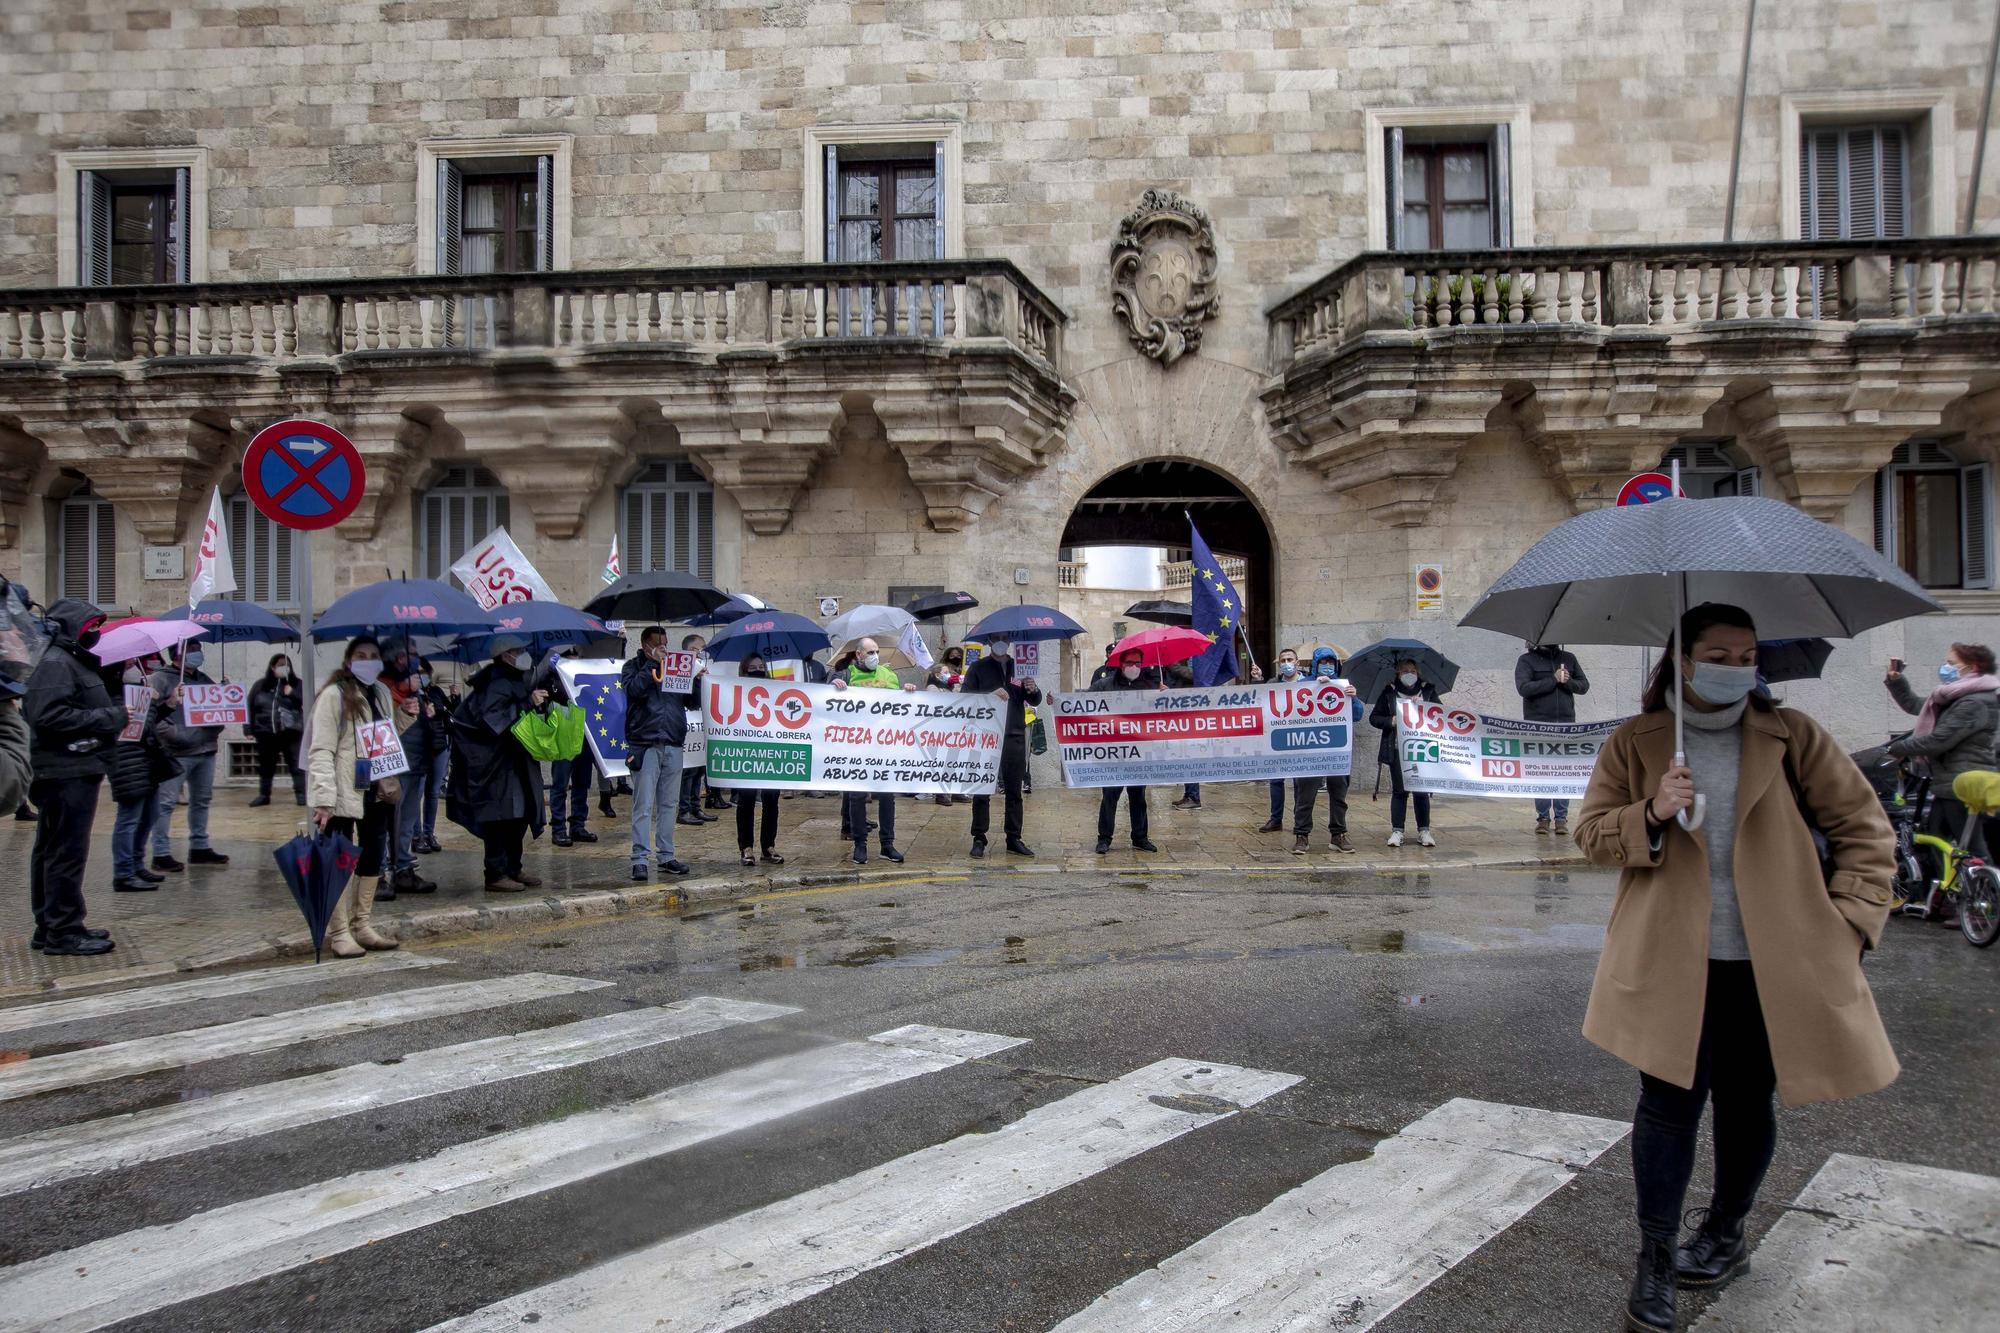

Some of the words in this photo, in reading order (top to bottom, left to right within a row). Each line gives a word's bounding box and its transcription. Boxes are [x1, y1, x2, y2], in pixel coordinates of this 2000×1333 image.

[1016, 644, 1037, 660] 16
[667, 653, 692, 672] 18
[188, 685, 244, 704] USO
[1060, 699, 1110, 714] CADA
[1154, 695, 1211, 710] FIXESA
[1218, 689, 1257, 706] ARA!
[1269, 686, 1345, 718] USO
[710, 684, 813, 730] USO
[825, 698, 866, 714] STOP
[870, 701, 912, 716] OPES
[915, 704, 996, 720] ILEGALES
[203, 710, 236, 722] CAIB
[1288, 718, 1316, 726] SINDICAL
[1319, 716, 1347, 724] OBRERA
[1403, 703, 1476, 735] USO
[708, 727, 731, 736] UNIÓ
[733, 729, 774, 738] SINDICAL
[776, 731, 812, 740] OBRERA
[1062, 720, 1115, 736] INTERÍ
[1120, 721, 1141, 735] EN
[1146, 718, 1190, 733] FRAU
[1195, 717, 1217, 731] DE
[1222, 715, 1257, 730] LLEI
[1540, 725, 1569, 733] DRET
[1570, 725, 1585, 734] DE
[824, 725, 872, 745] FIJEZA
[877, 728, 916, 747] COMO
[920, 725, 977, 749] SANCIÓN
[981, 731, 999, 750] YA!
[1286, 730, 1330, 747] IMAS
[1420, 732, 1447, 740] SINDICAL
[712, 747, 789, 759] AJUNTAMENT
[792, 751, 806, 760] DE
[1064, 746, 1141, 761] IMPORTA
[1488, 740, 1511, 755] SI
[1523, 742, 1604, 756] FIXES
[383, 754, 403, 763] FRAU
[823, 756, 848, 764] OPES
[849, 757, 862, 765] NO
[865, 758, 883, 766] SON
[886, 758, 897, 767] LA
[900, 758, 945, 768] SOLUCIÓN
[947, 761, 981, 769] CONTRA
[984, 762, 994, 770] EL
[373, 765, 385, 775] DE
[388, 760, 404, 771] LLEI
[712, 760, 806, 775] LLUCMAJOR
[1488, 761, 1516, 776] NO
[823, 768, 868, 780] ABUSO
[873, 770, 890, 781] DE
[894, 770, 996, 784] TEMPORALIDAD
